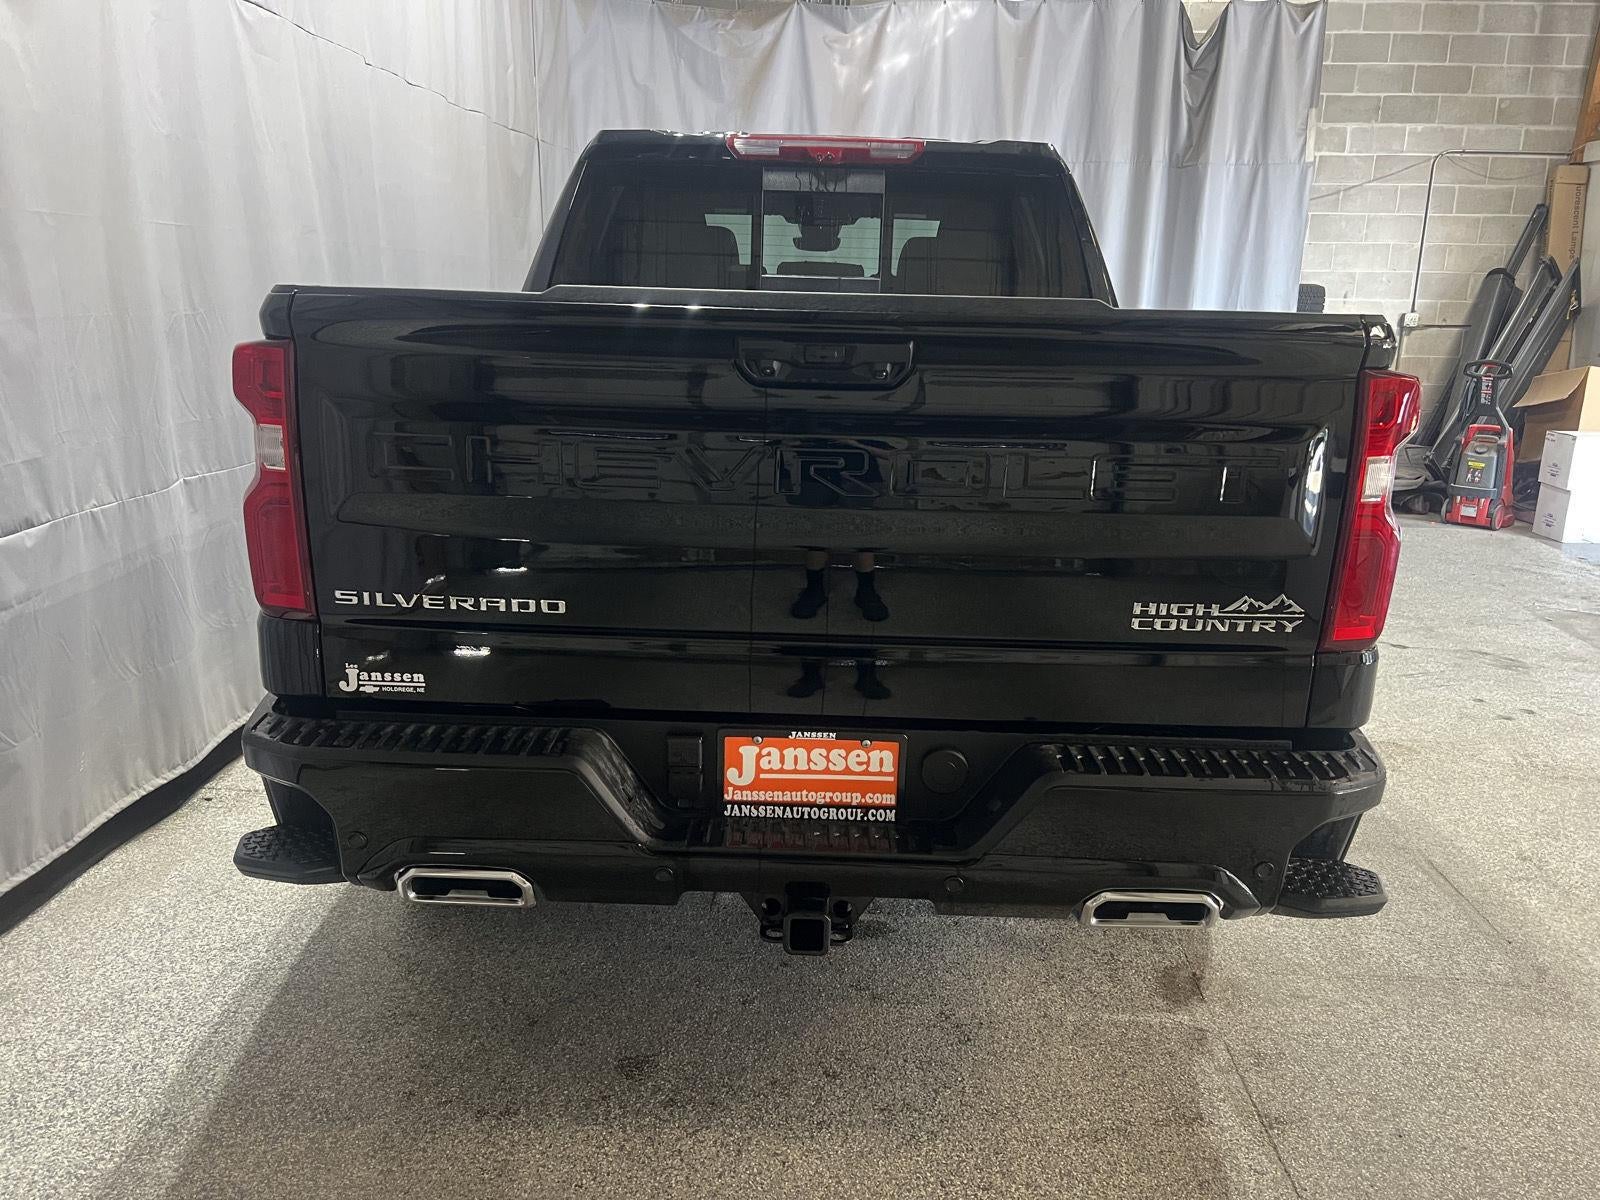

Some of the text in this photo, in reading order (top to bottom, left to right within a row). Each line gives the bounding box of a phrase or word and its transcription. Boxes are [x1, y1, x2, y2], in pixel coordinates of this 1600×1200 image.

[334, 589, 567, 614] SILVERADO
[1132, 602, 1221, 616] HIGH
[1130, 617, 1303, 633] COUNTRY
[338, 668, 425, 692] Janssen
[788, 731, 837, 740] JANSSEN
[726, 745, 895, 786] Janssen
[724, 786, 896, 805] Janssenautogroup.com
[723, 804, 896, 822] JANSSENAUTOGROUP.COM
